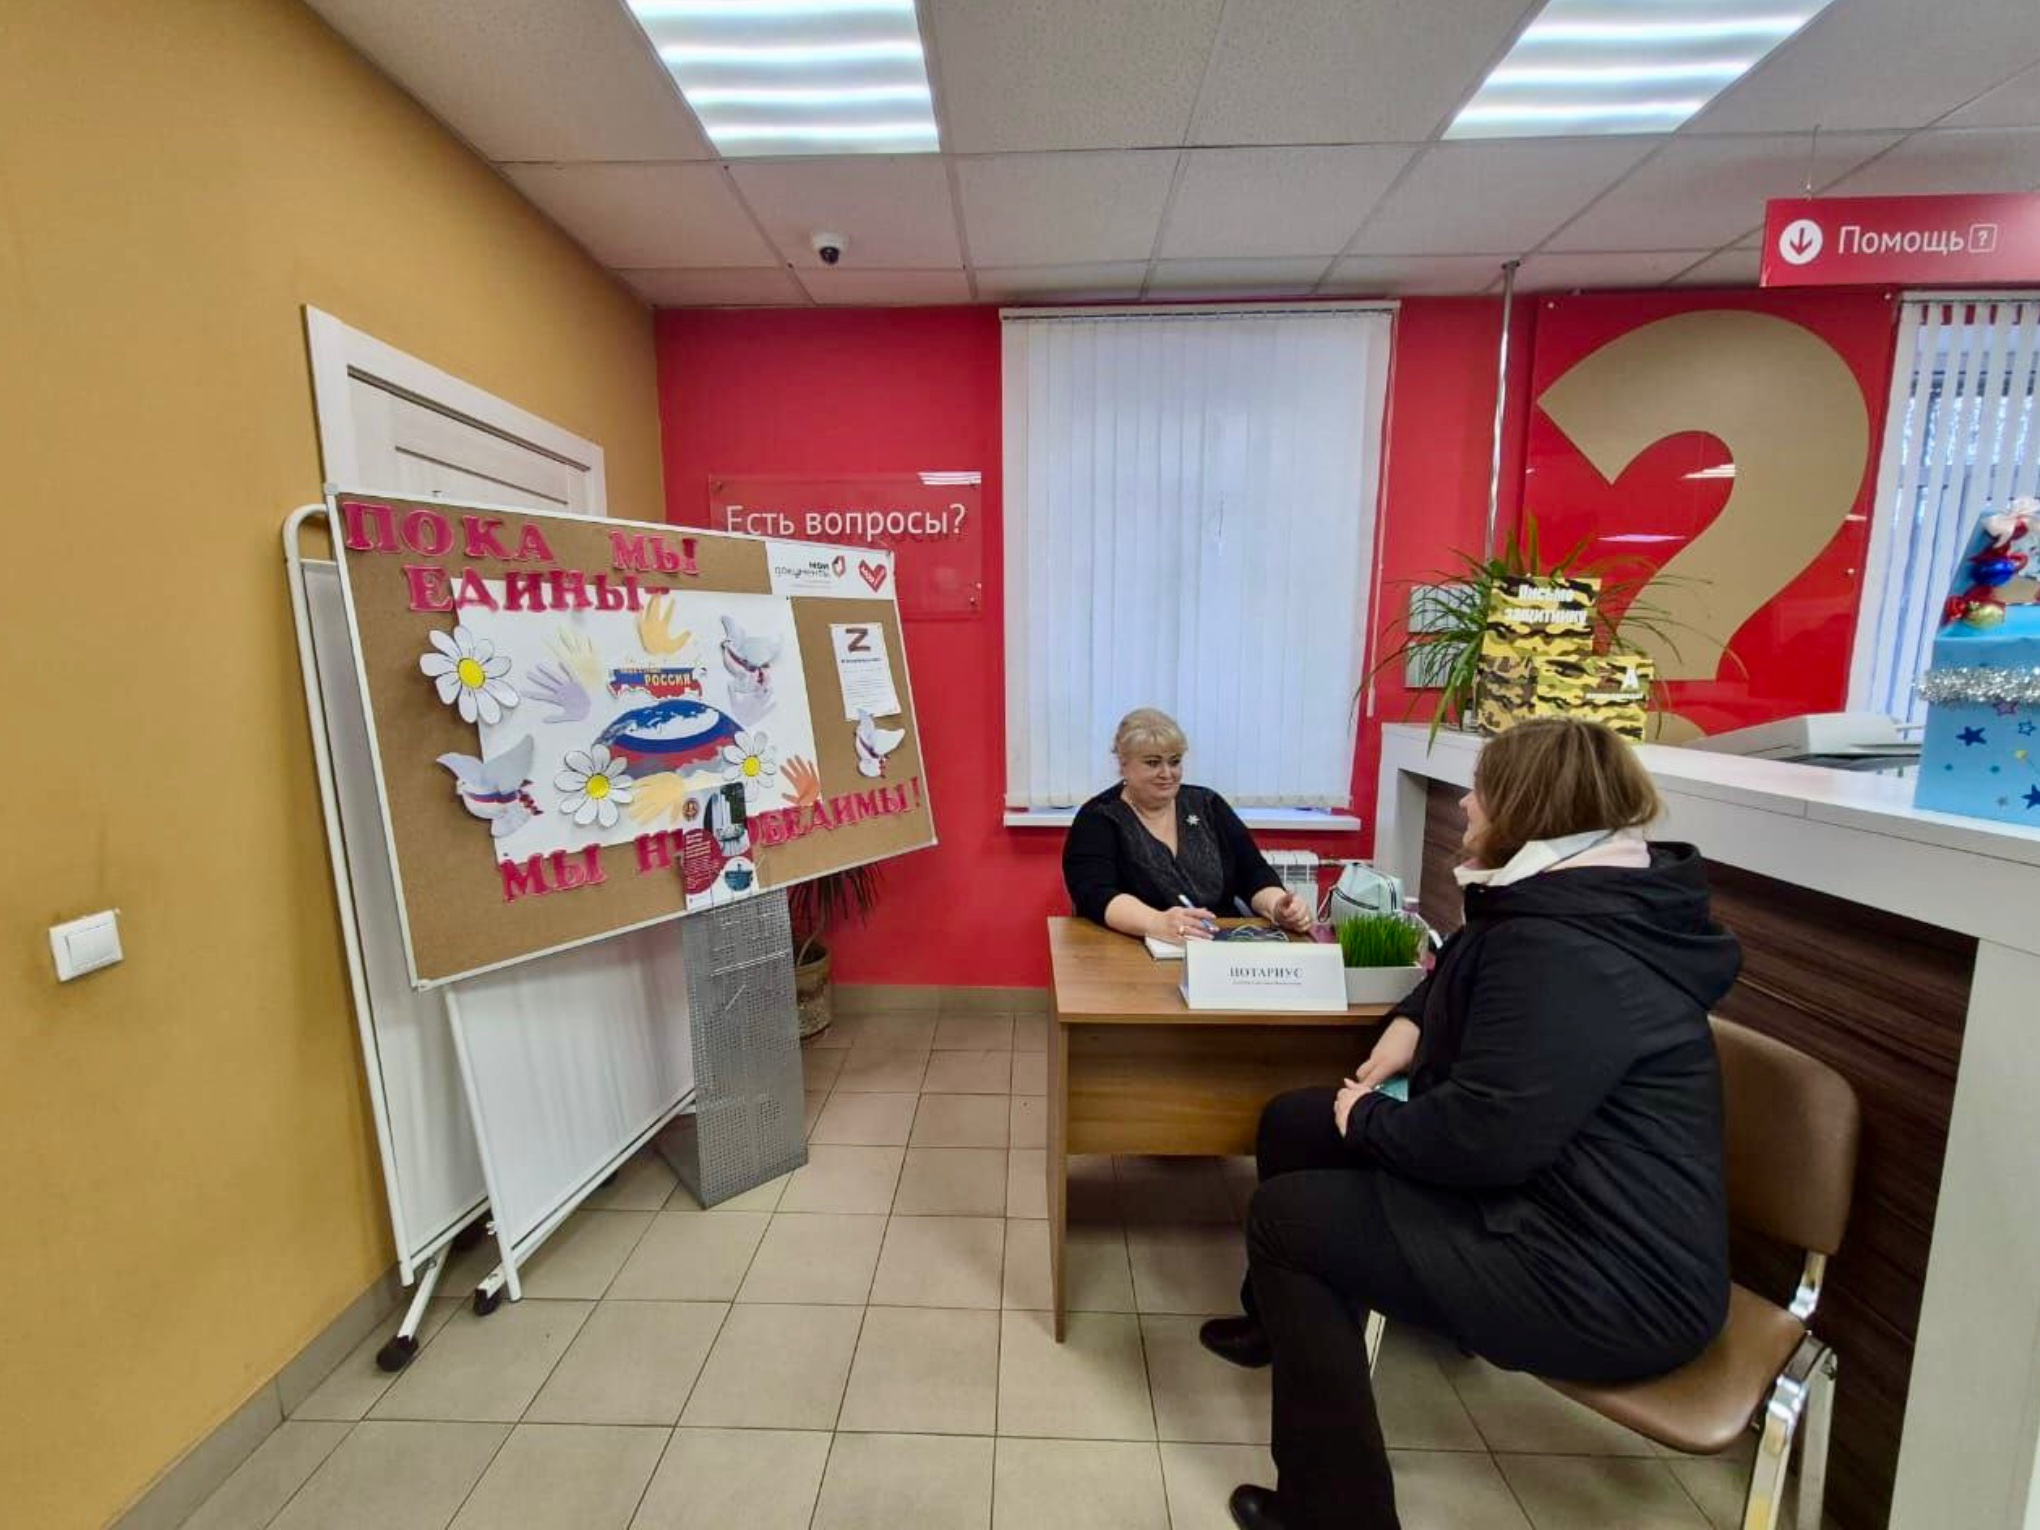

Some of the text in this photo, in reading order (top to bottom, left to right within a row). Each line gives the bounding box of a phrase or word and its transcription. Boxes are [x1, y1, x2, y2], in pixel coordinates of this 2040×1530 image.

[1838, 225, 1965, 255] Помощь
[343, 501, 700, 575] ПОКА МЫ
[726, 503, 966, 541] Есть вопросы?
[845, 628, 871, 652] Z
[500, 843, 608, 902] МЫ
